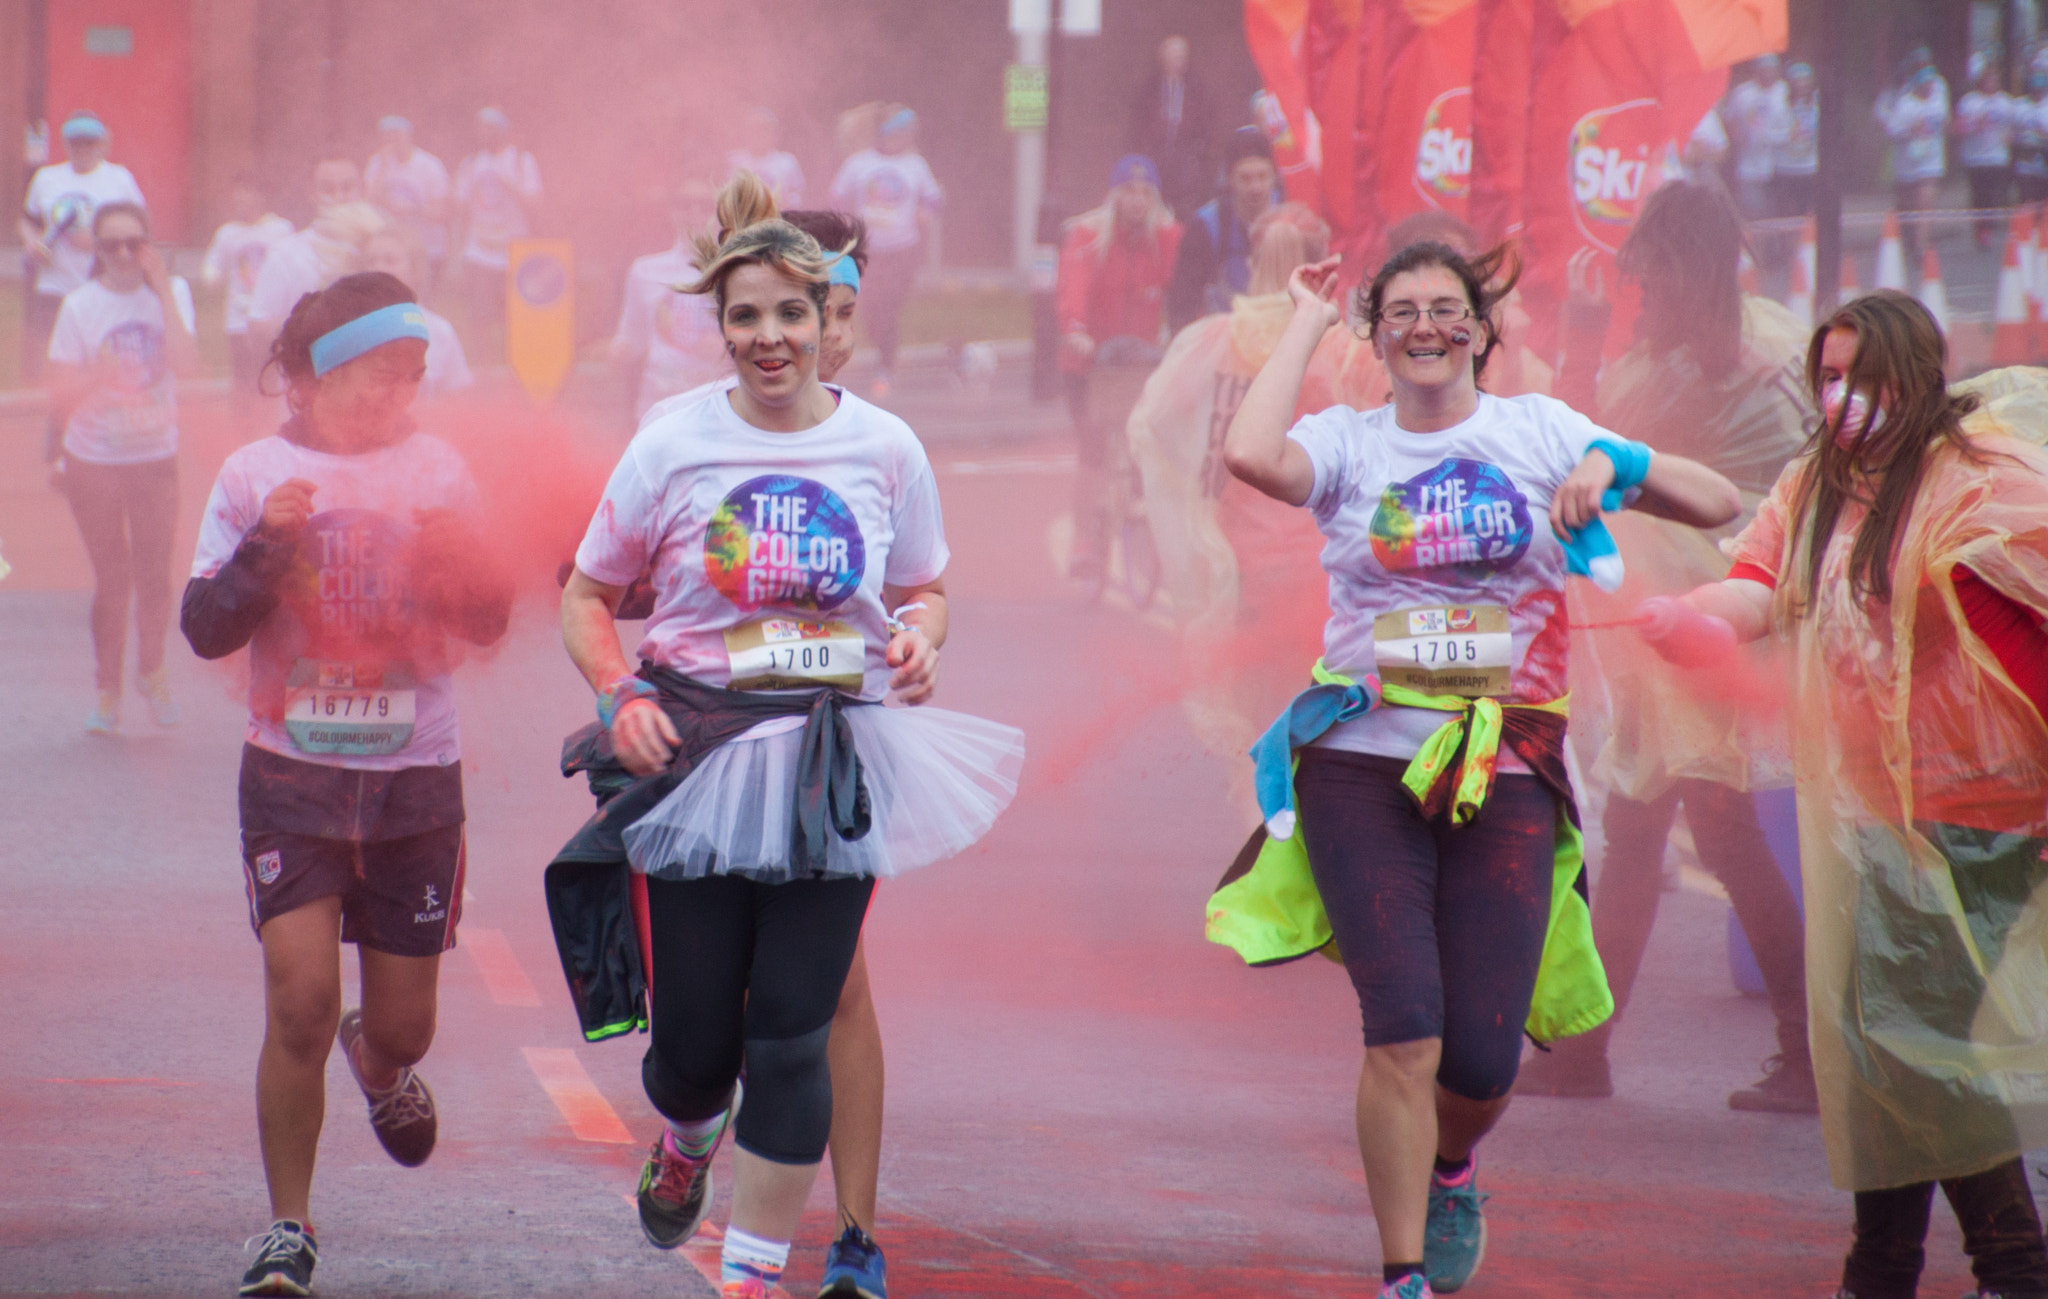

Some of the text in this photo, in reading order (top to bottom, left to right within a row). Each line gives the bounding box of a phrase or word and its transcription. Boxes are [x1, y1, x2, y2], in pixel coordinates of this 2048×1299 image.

[1420, 478, 1469, 513] THE
[751, 493, 807, 534] THE
[1415, 500, 1517, 544] COLOR
[317, 530, 372, 564] THE
[749, 531, 848, 574] COLOR
[1415, 541, 1482, 568] RUN
[747, 567, 809, 603] RUN
[769, 646, 829, 670] 1700
[1412, 640, 1476, 663] 1705
[1406, 674, 1489, 688] #COLOURMEHAPPY
[311, 695, 389, 717] 16779
[308, 730, 392, 744] #COLOURMEHAPPY
